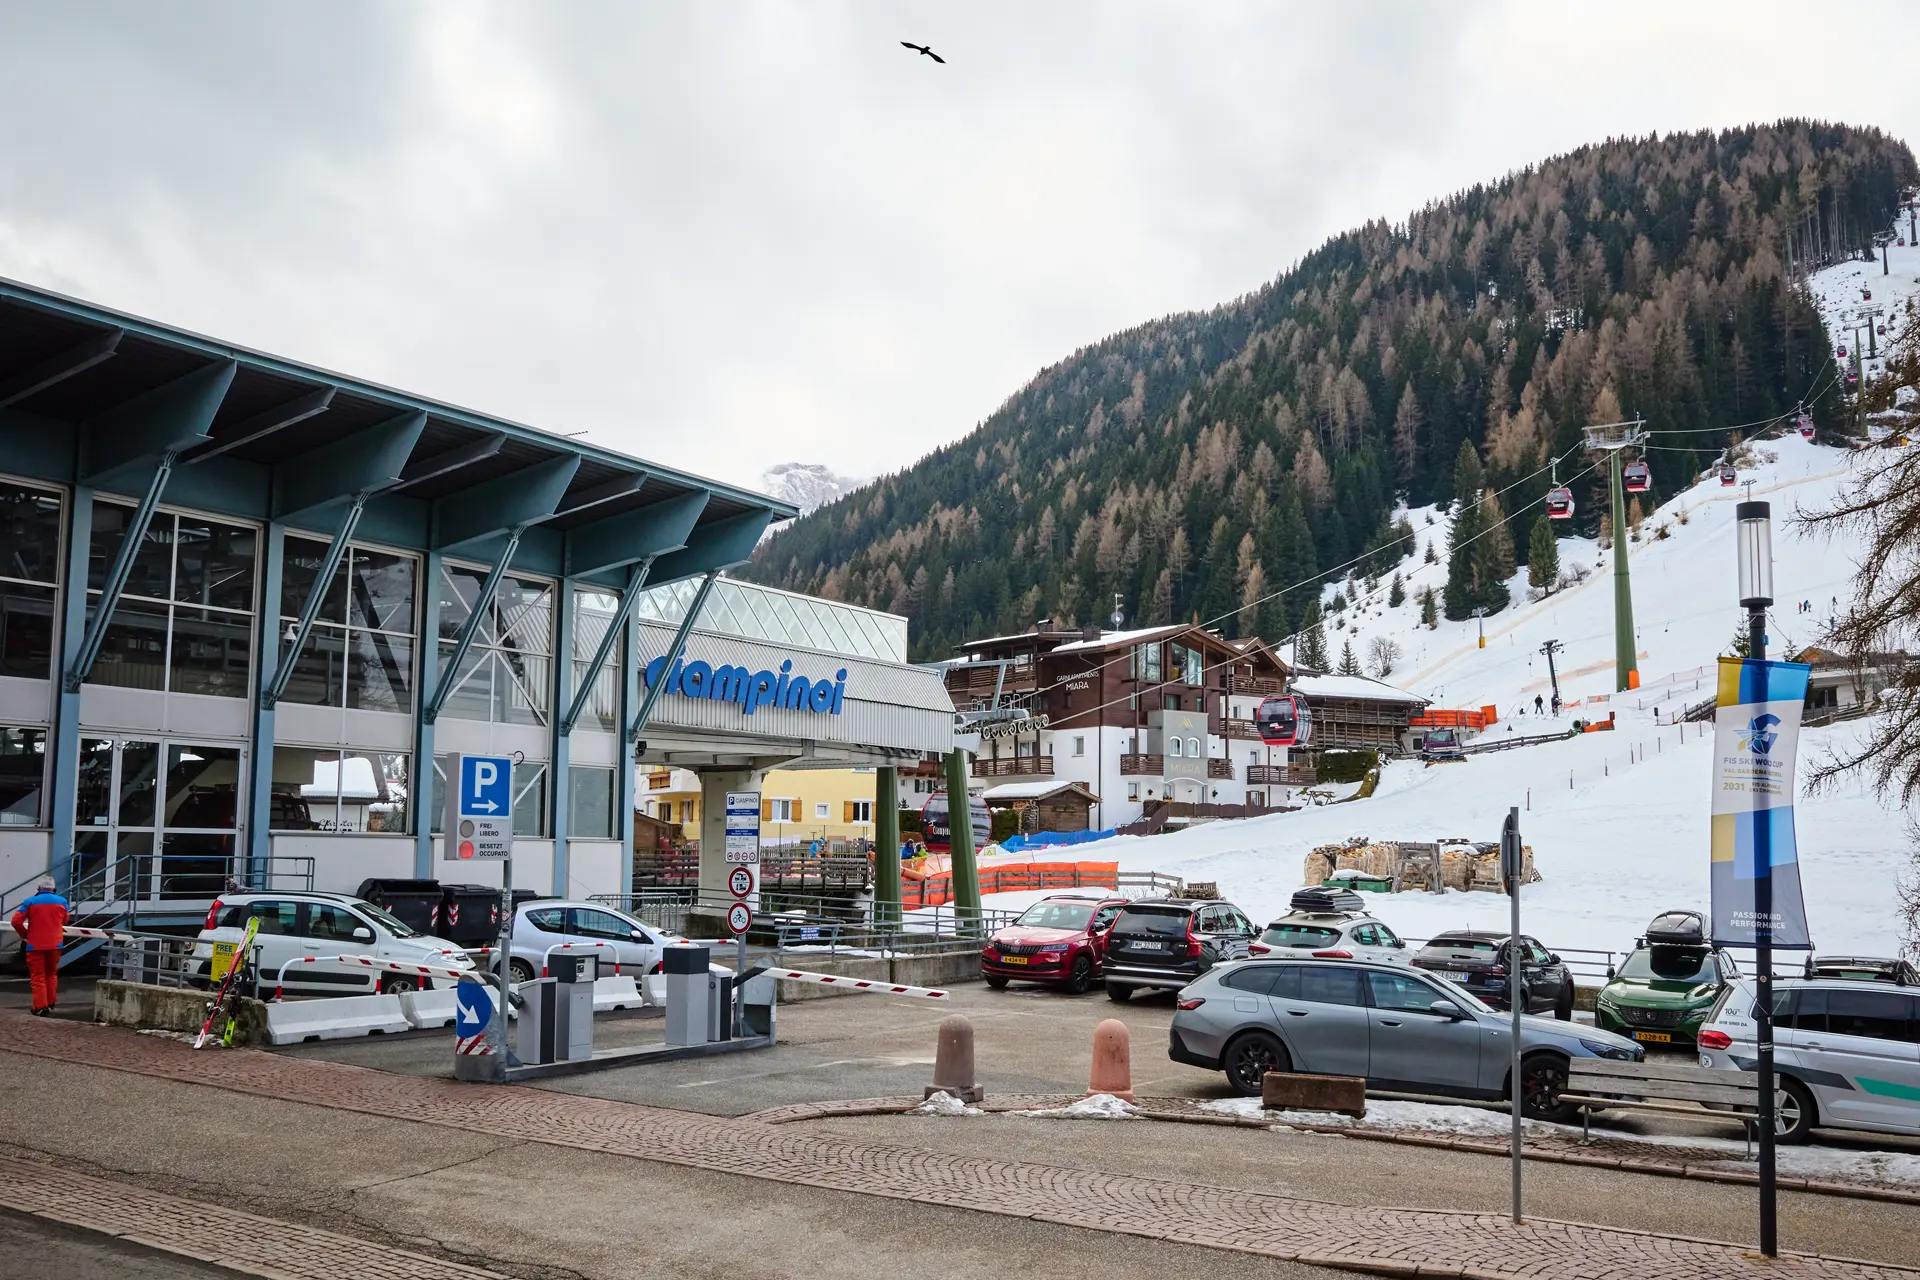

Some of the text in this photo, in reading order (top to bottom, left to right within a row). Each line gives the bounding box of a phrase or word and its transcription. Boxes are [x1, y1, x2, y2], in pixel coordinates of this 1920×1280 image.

[1066, 681, 1089, 691] MIARA
[1171, 763, 1200, 773] MIARA
[1773, 760, 1784, 768] CUP
[474, 761, 498, 798] P
[1723, 782, 1745, 791] 2031
[1733, 911, 1768, 920] PASSION
[1730, 920, 1786, 929] PERFORMANCE
[216, 943, 232, 952] FREE
[1638, 1033, 1668, 1041] T-328-KX
